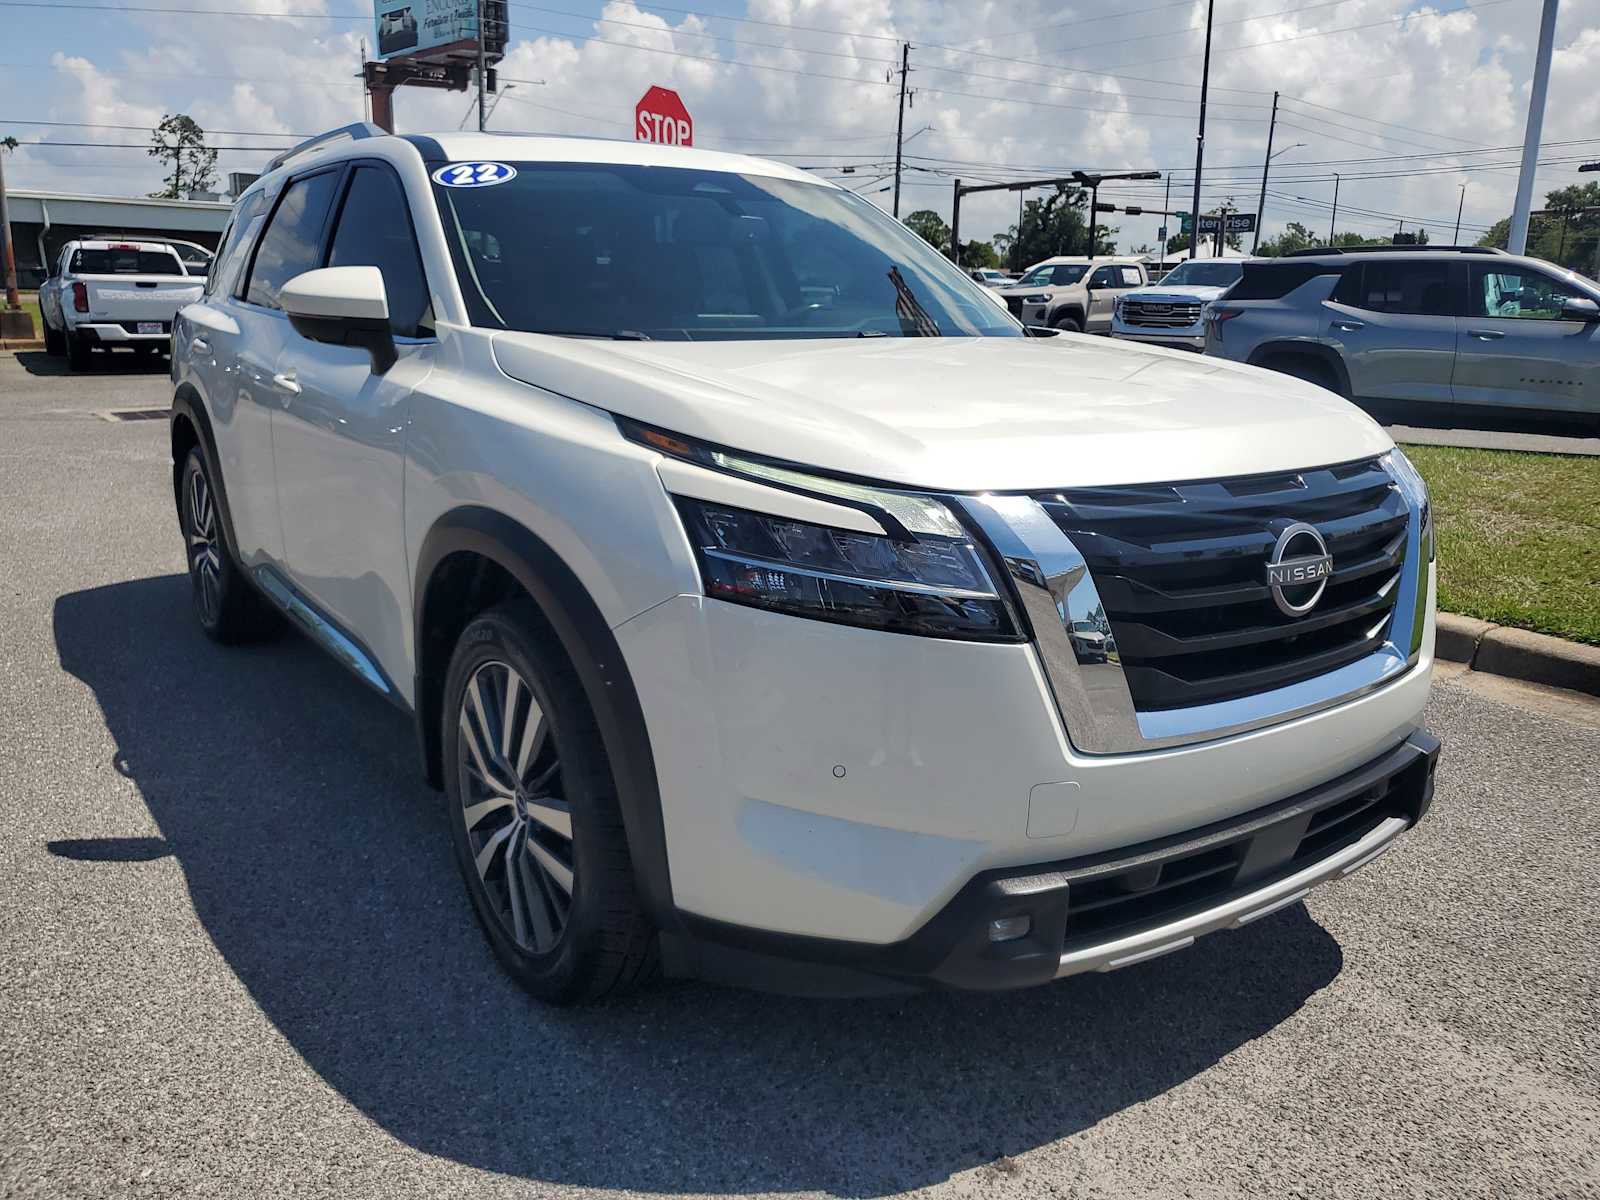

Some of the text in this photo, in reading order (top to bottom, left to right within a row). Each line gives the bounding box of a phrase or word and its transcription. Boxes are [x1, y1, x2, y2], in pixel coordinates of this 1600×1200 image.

[639, 110, 690, 145] STOP
[451, 164, 499, 185] 22
[1143, 304, 1171, 312] GMC
[1269, 560, 1333, 583] NISSAN
